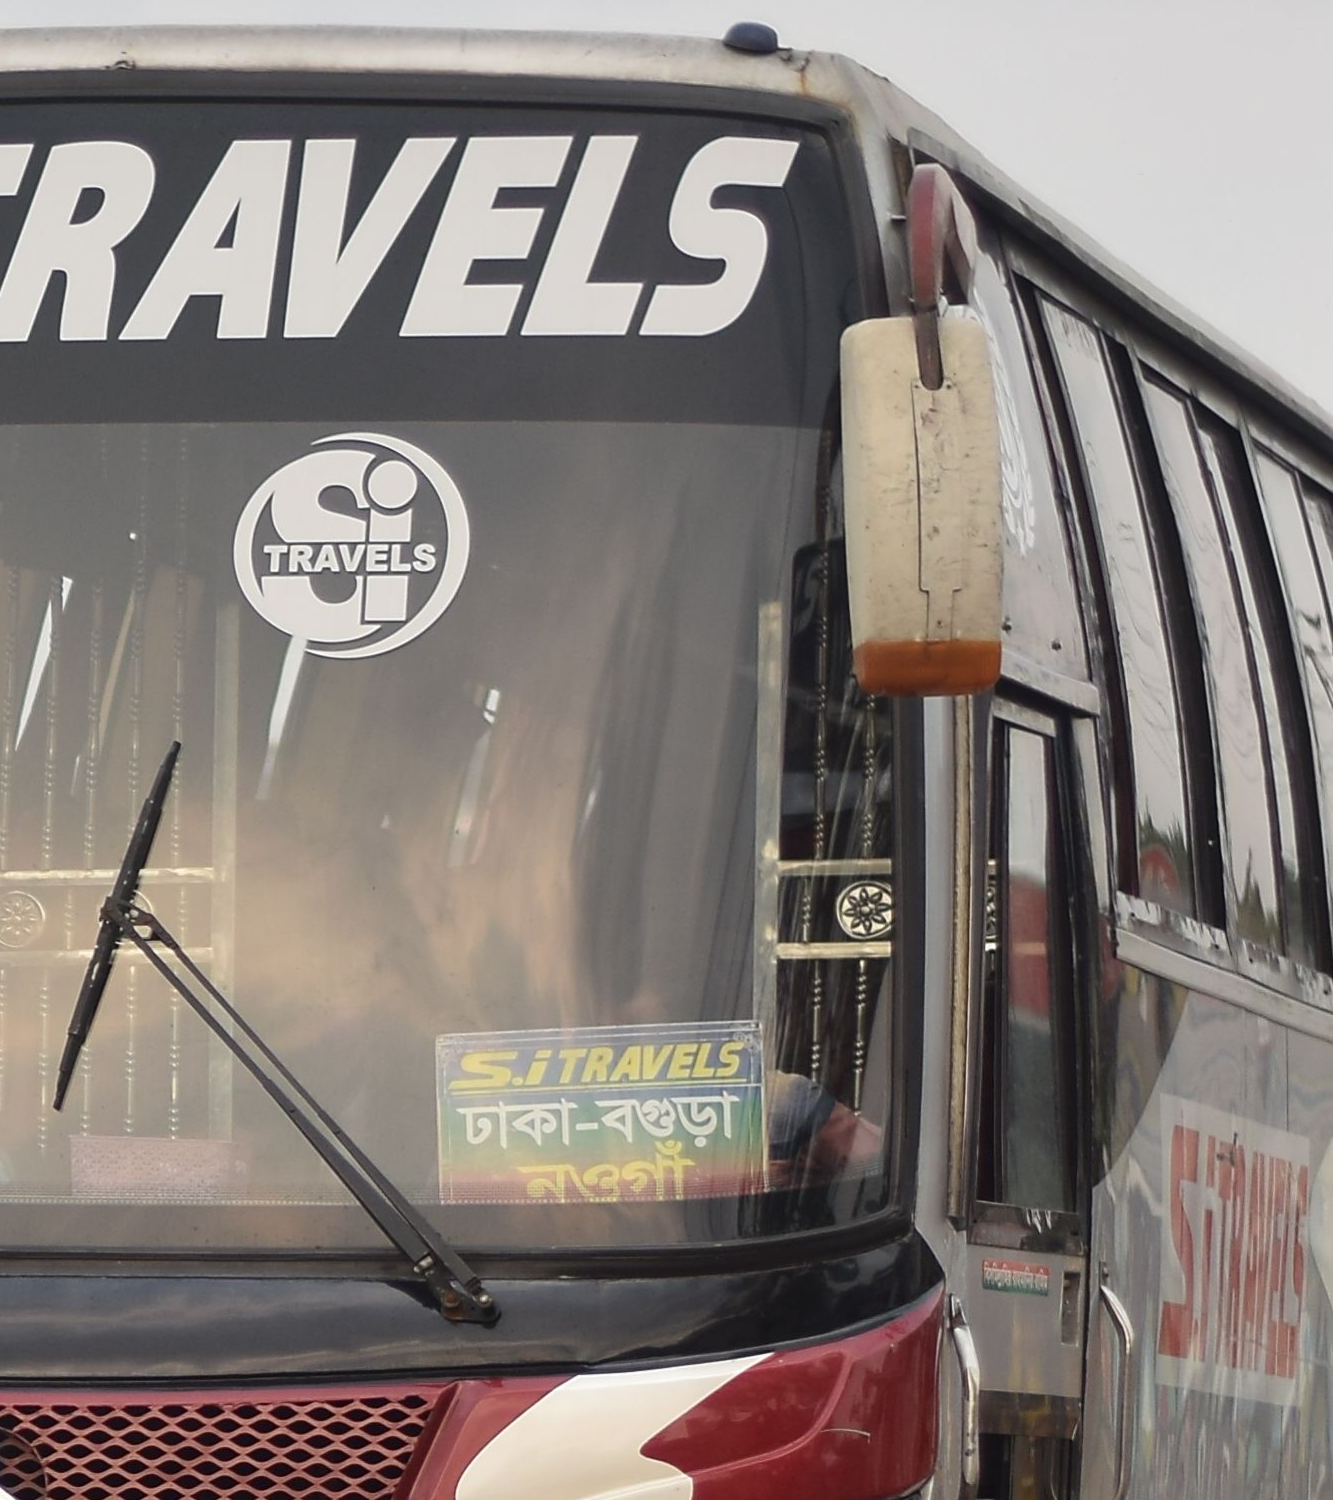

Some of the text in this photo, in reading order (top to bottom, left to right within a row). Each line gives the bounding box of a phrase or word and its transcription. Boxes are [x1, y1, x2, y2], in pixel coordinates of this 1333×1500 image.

[263, 543, 437, 574] TRAVELS
[558, 1041, 745, 1085] TRAVELS
[456, 1090, 740, 1148] ঢাকা-বগুড়া
